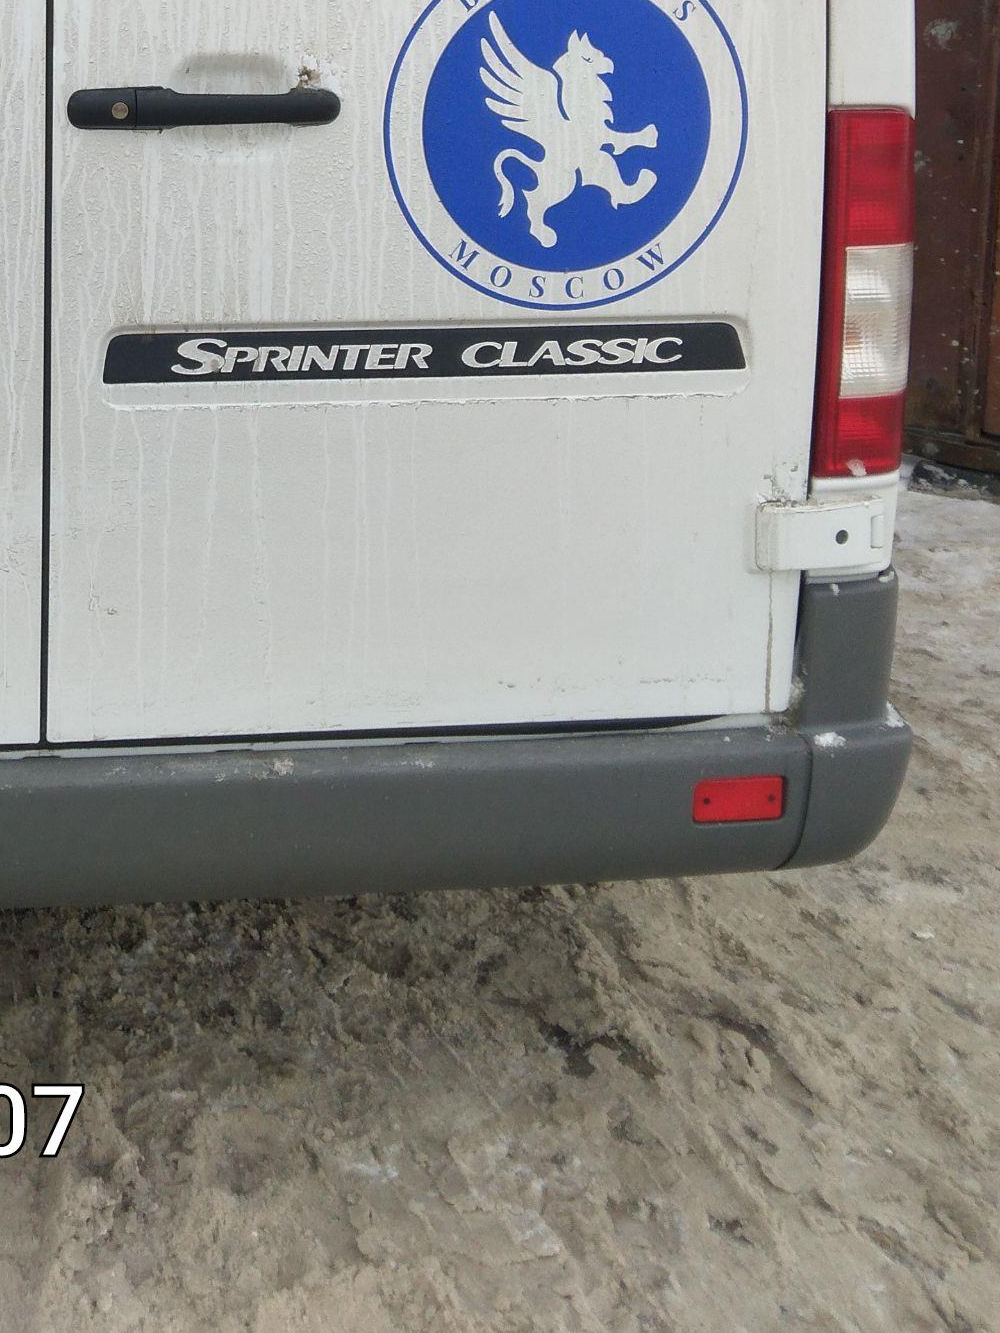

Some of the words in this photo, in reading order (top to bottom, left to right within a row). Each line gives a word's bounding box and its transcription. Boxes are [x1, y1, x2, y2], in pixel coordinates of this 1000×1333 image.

[448, 238, 667, 300] MOSCOW
[171, 337, 433, 376] SPRINTER
[460, 336, 684, 369] CLASSIC
